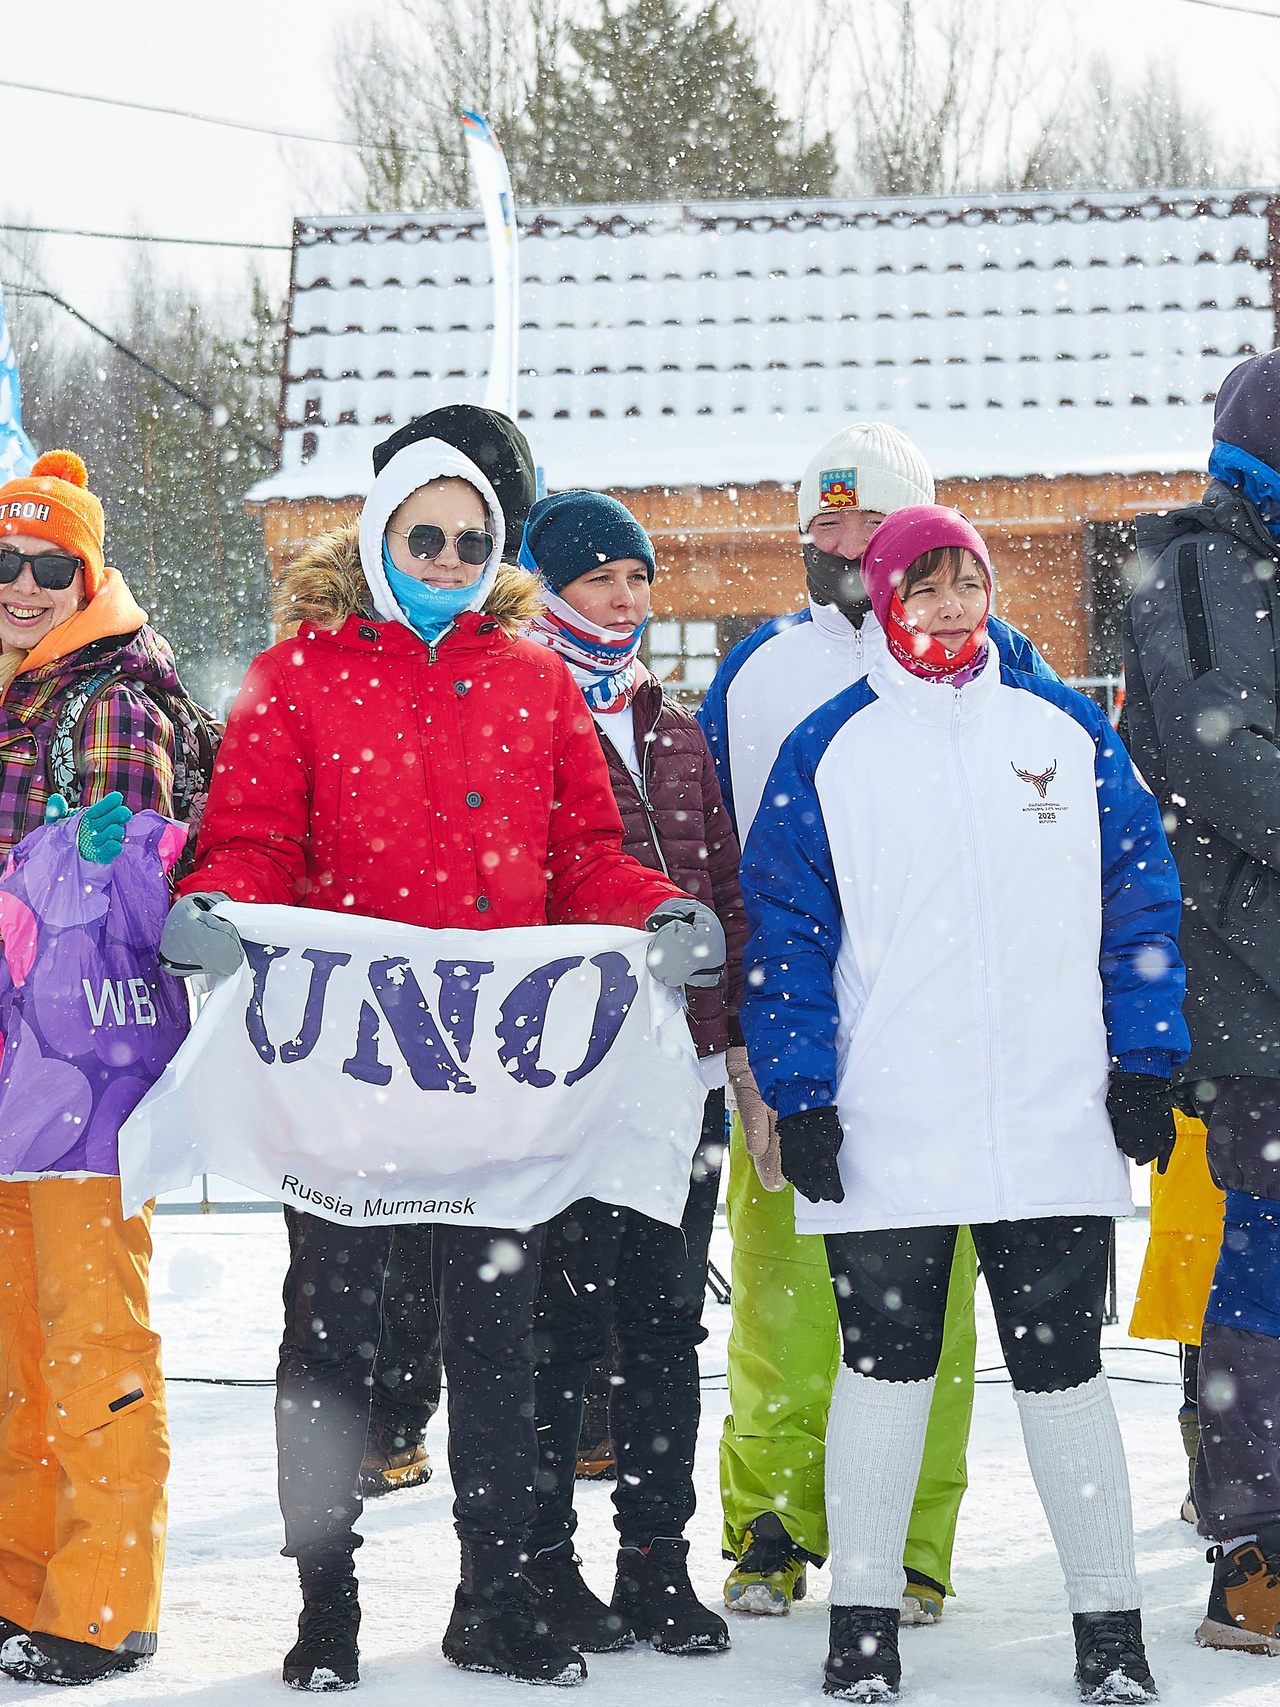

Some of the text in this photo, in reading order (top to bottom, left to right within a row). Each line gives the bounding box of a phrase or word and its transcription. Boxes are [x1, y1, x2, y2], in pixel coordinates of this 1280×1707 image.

[1037, 812, 1056, 820] 2025
[81, 978, 157, 1026] WB
[240, 938, 639, 1095] UNO
[281, 1174, 477, 1218] Russia Murmansk
